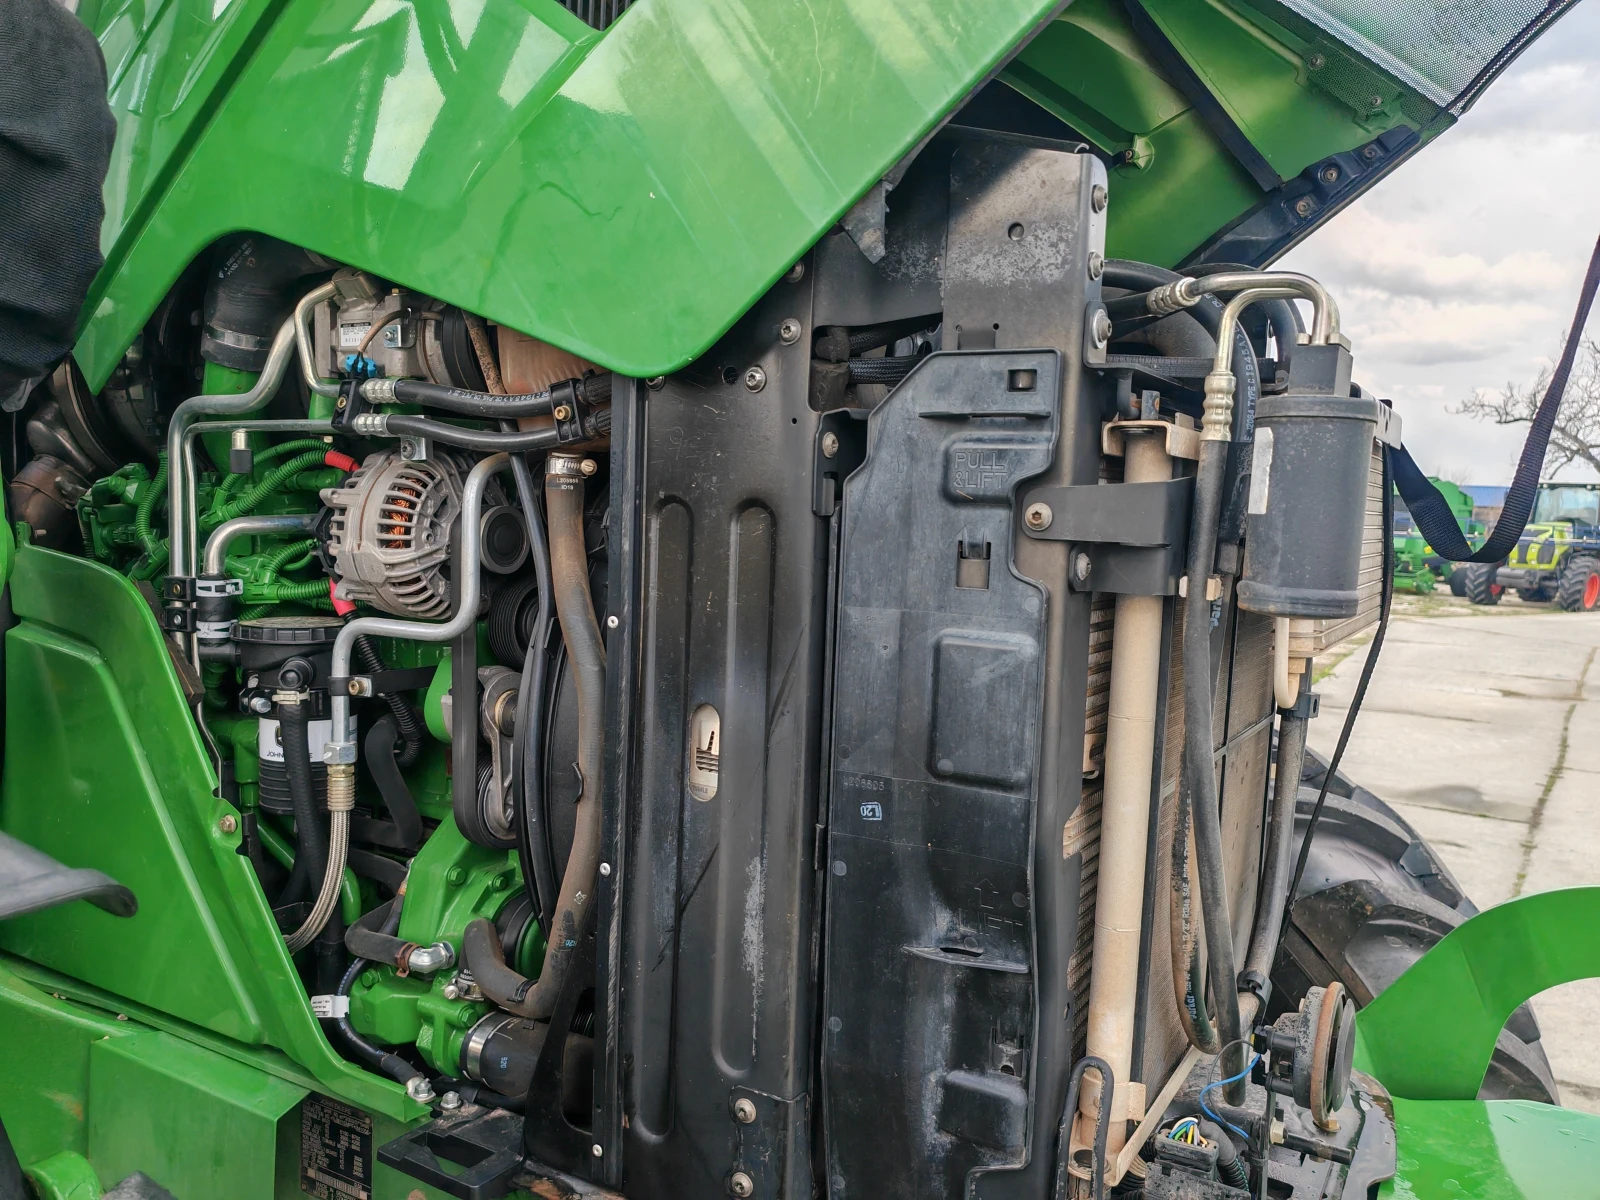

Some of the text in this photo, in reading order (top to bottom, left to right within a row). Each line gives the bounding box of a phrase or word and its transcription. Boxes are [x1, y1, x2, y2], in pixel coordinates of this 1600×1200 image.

[1247, 386, 1256, 407] TYPE
[954, 450, 1005, 469] PULL
[953, 469, 1008, 489] &LIFT
[267, 750, 284, 758] JOHN
[1182, 882, 1191, 897] SAE
[957, 907, 1025, 944] LIFT
[1185, 994, 1198, 1020] Parker
